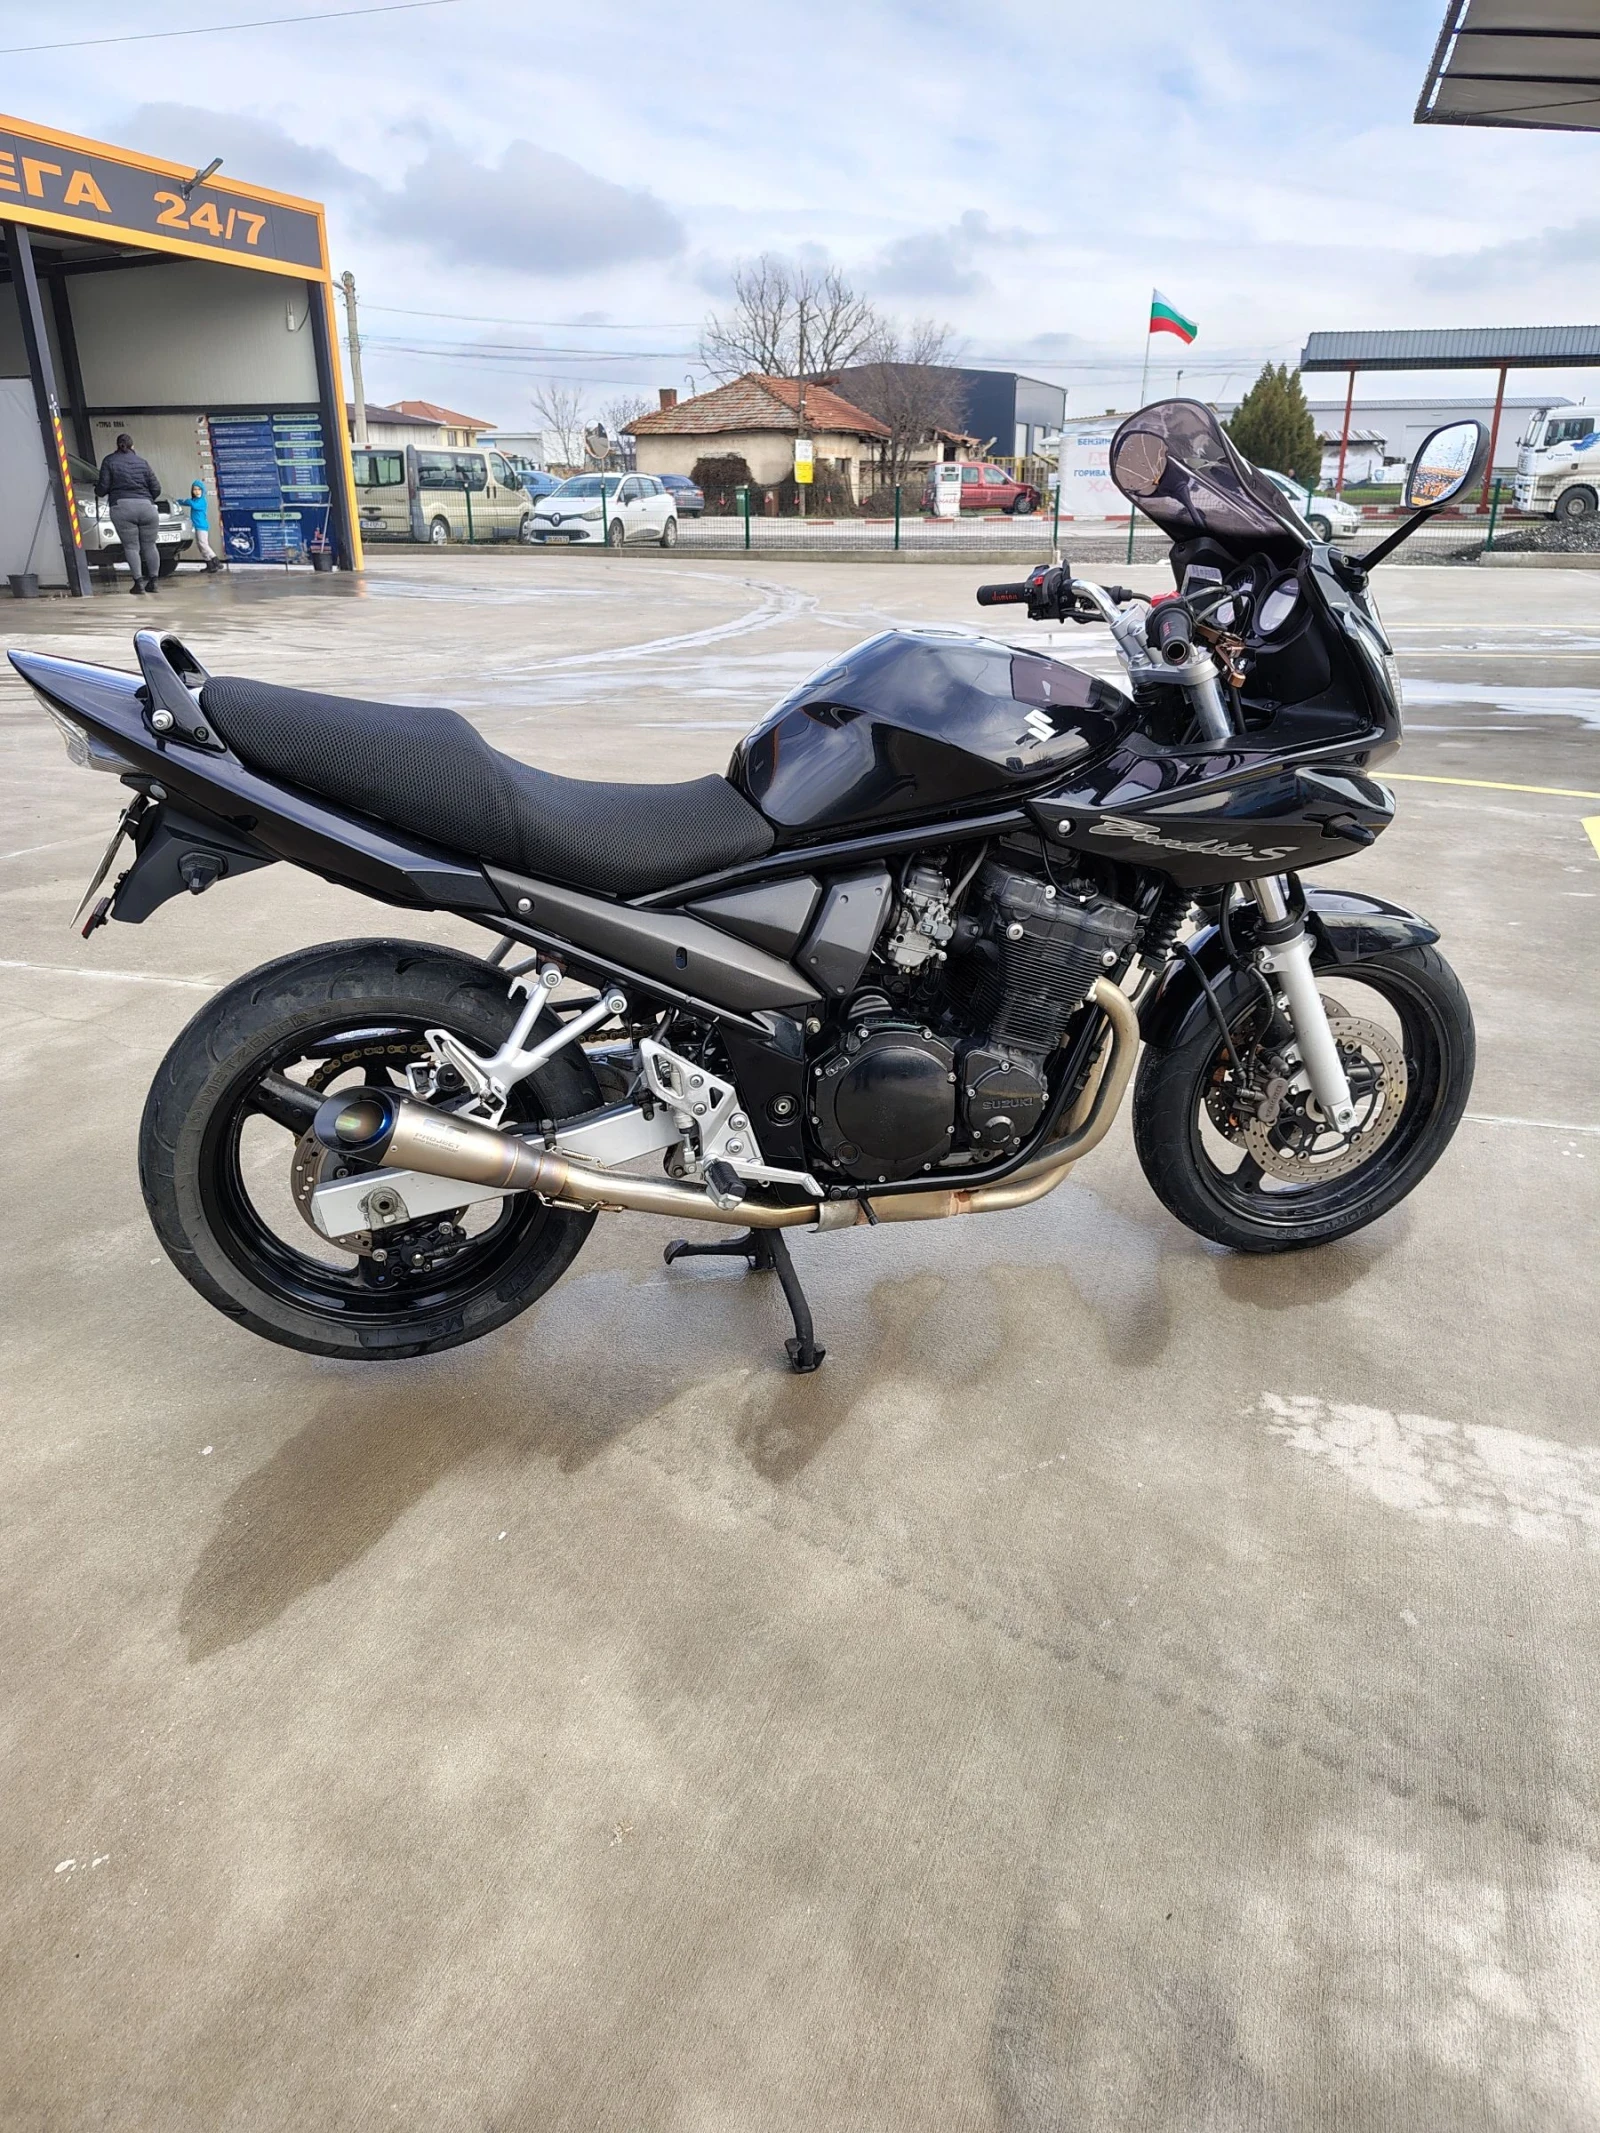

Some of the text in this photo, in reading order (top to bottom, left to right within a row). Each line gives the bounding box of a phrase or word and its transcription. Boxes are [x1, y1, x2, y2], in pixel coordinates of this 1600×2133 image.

[153, 191, 266, 245] 24/7
[1073, 469, 1107, 477] ГОРИВА
[1241, 846, 1300, 862] S
[200, 1012, 309, 1105] METZELER
[982, 1097, 1034, 1109] SUZUKI
